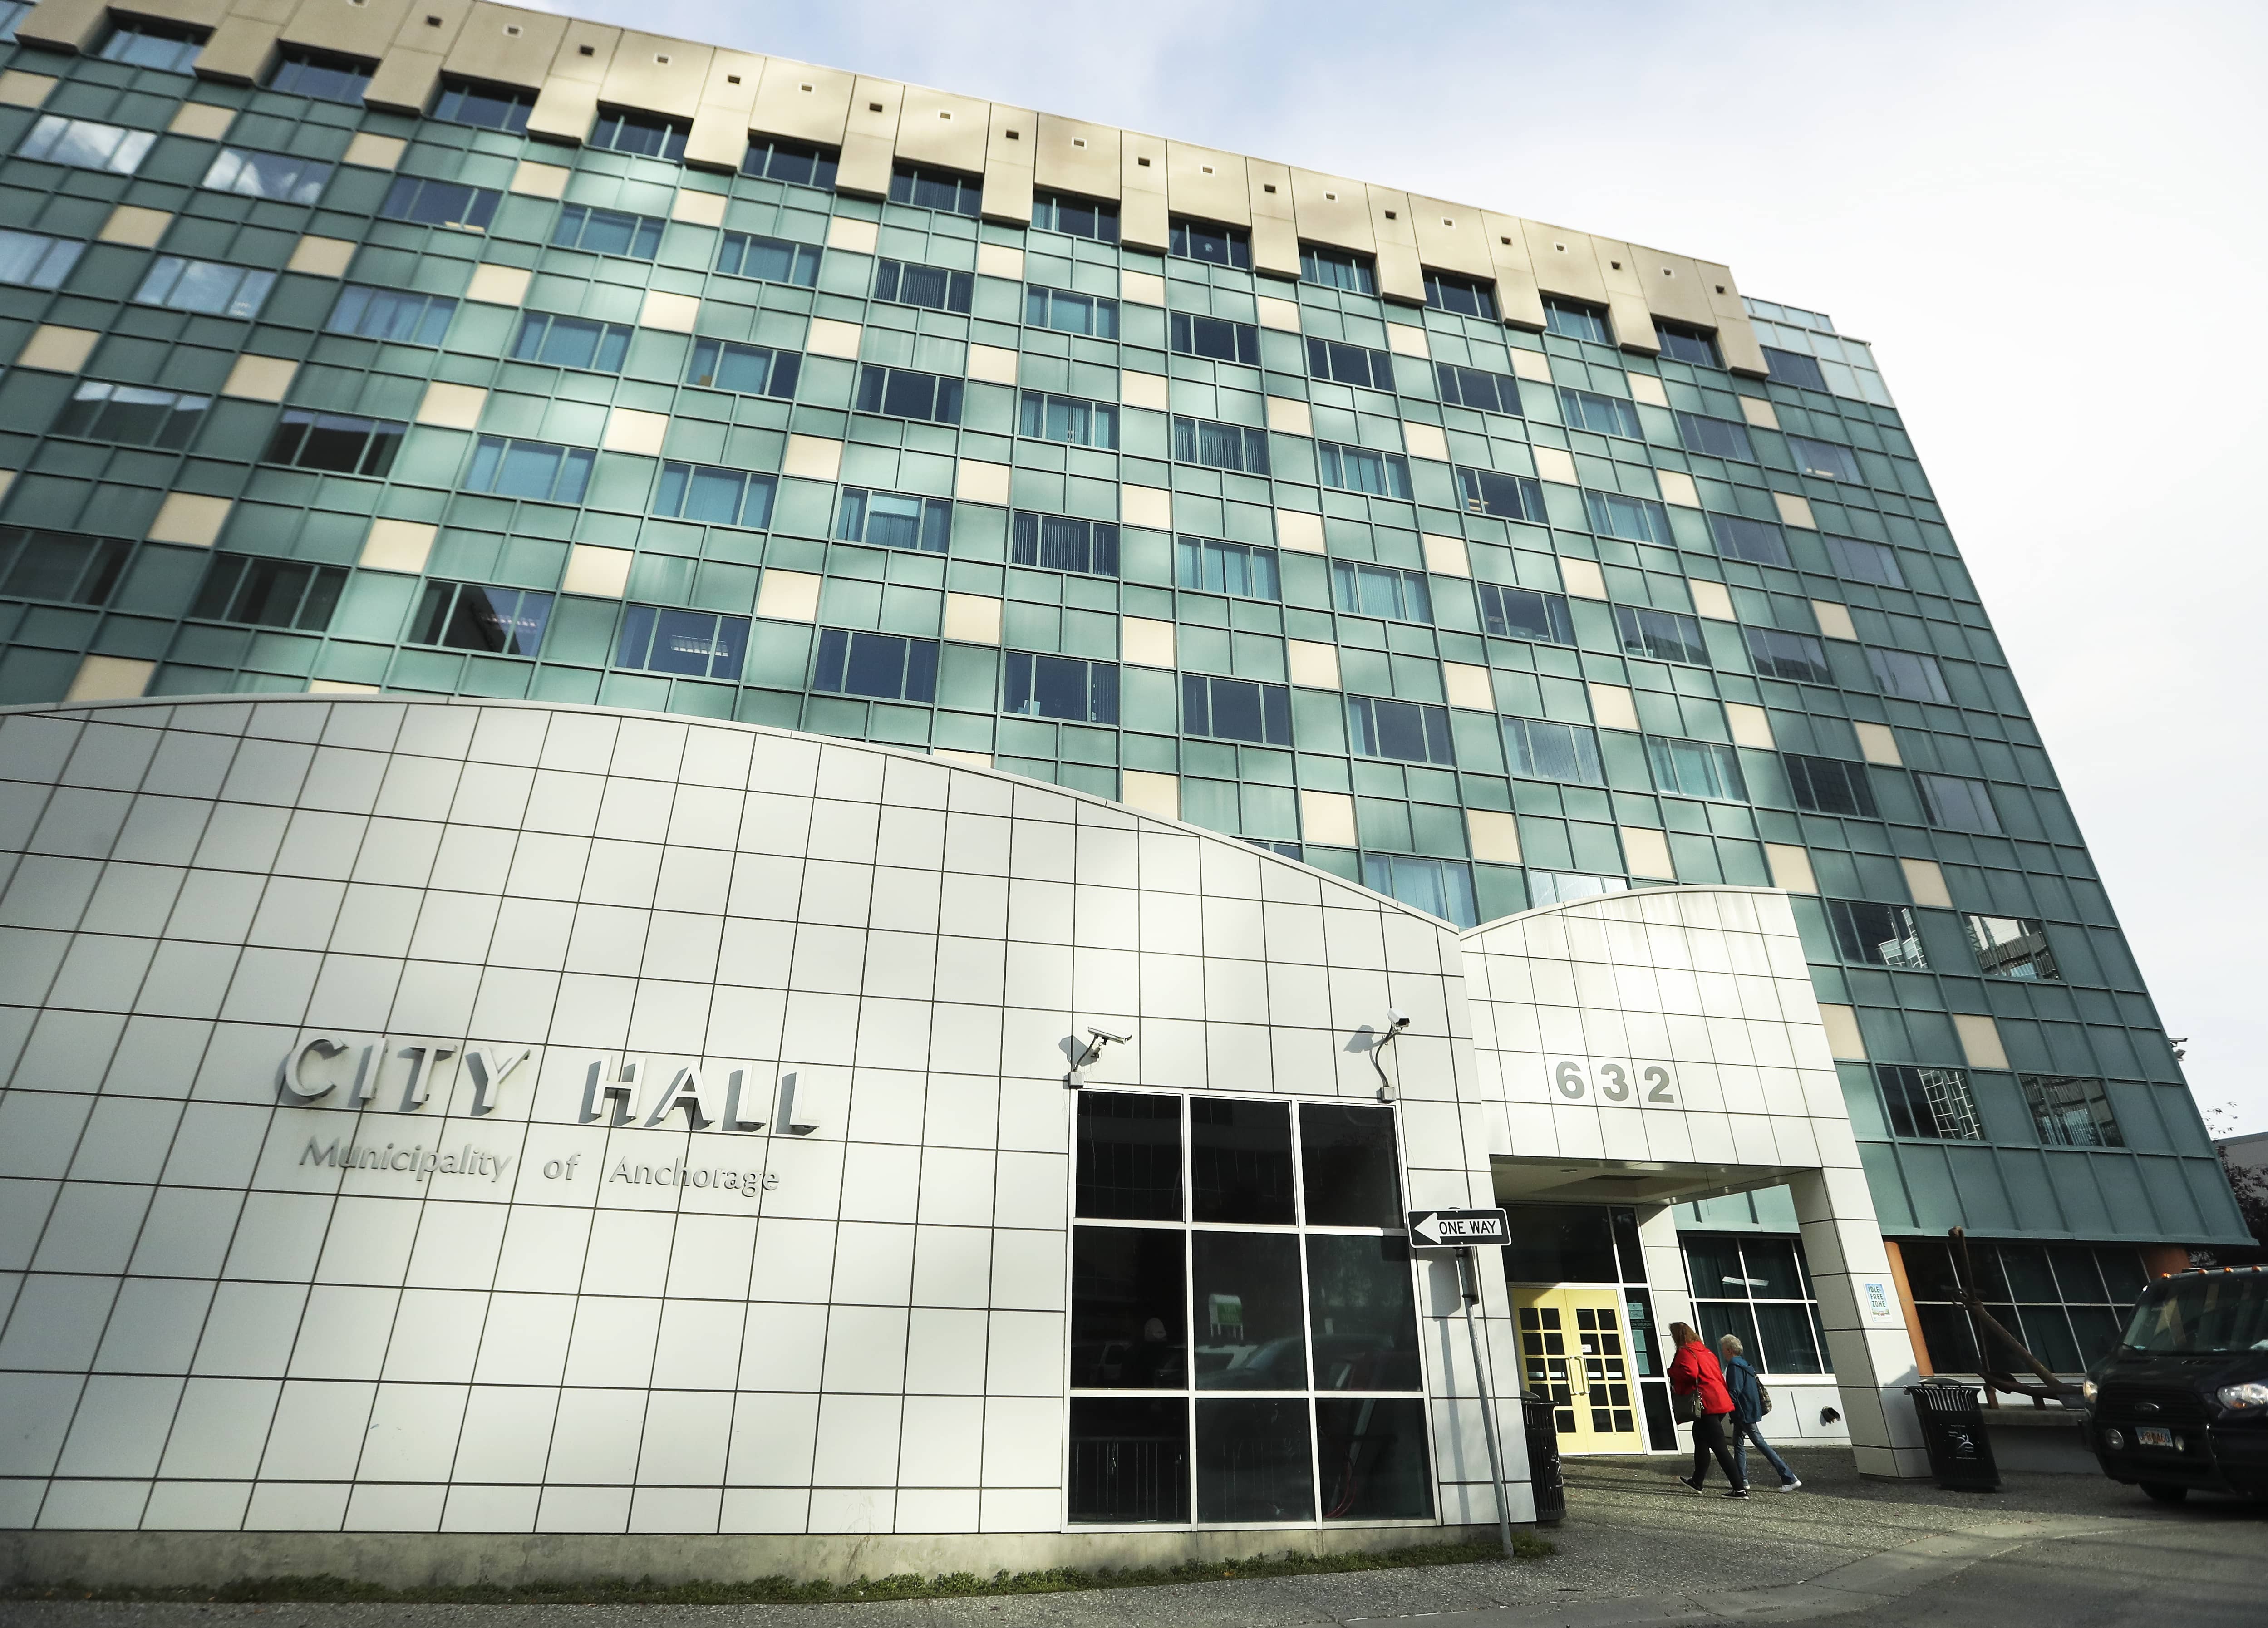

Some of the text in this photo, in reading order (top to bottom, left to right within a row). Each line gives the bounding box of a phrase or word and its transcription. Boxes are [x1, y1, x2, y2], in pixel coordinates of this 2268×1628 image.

[285, 1037, 820, 1127] CITY HALL
[1555, 1061, 1674, 1103] 632
[300, 1135, 780, 1197] Municipality of Anchorage
[1439, 1220, 1496, 1235] ONE WAY
